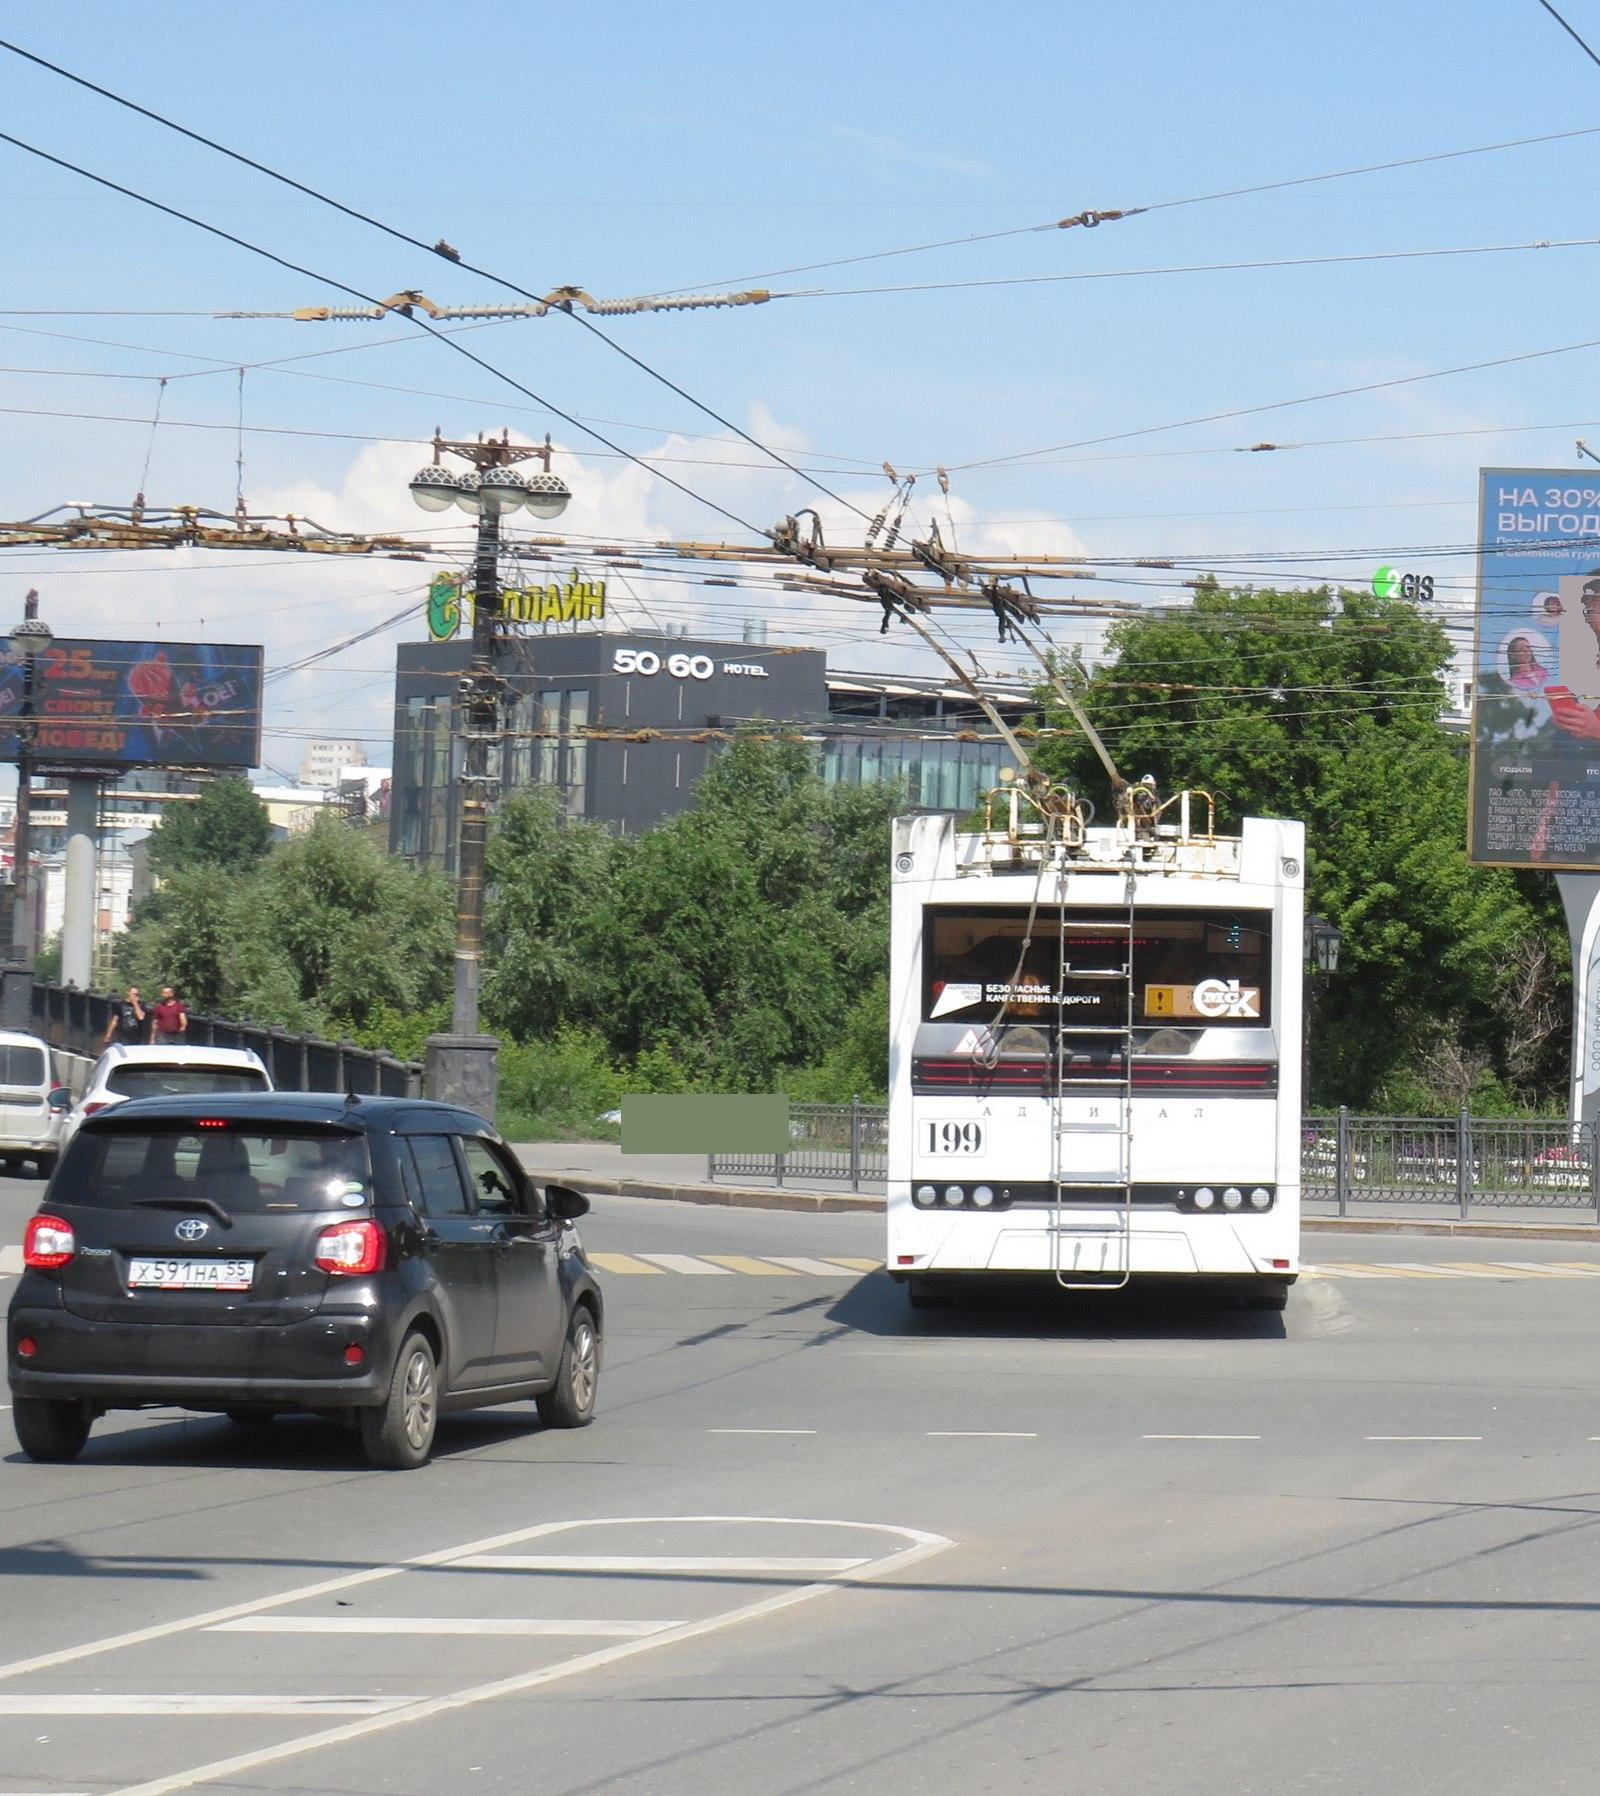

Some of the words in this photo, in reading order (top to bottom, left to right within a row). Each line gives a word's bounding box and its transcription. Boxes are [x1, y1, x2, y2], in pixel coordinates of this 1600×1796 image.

[1498, 487, 1538, 507] НА
[45, 648, 92, 678] 25
[613, 649, 660, 675] 50
[668, 653, 714, 680] 60
[723, 662, 770, 678] HOTEL
[1063, 996, 1101, 1005] ДОРОГИ
[926, 1121, 983, 1154] 199
